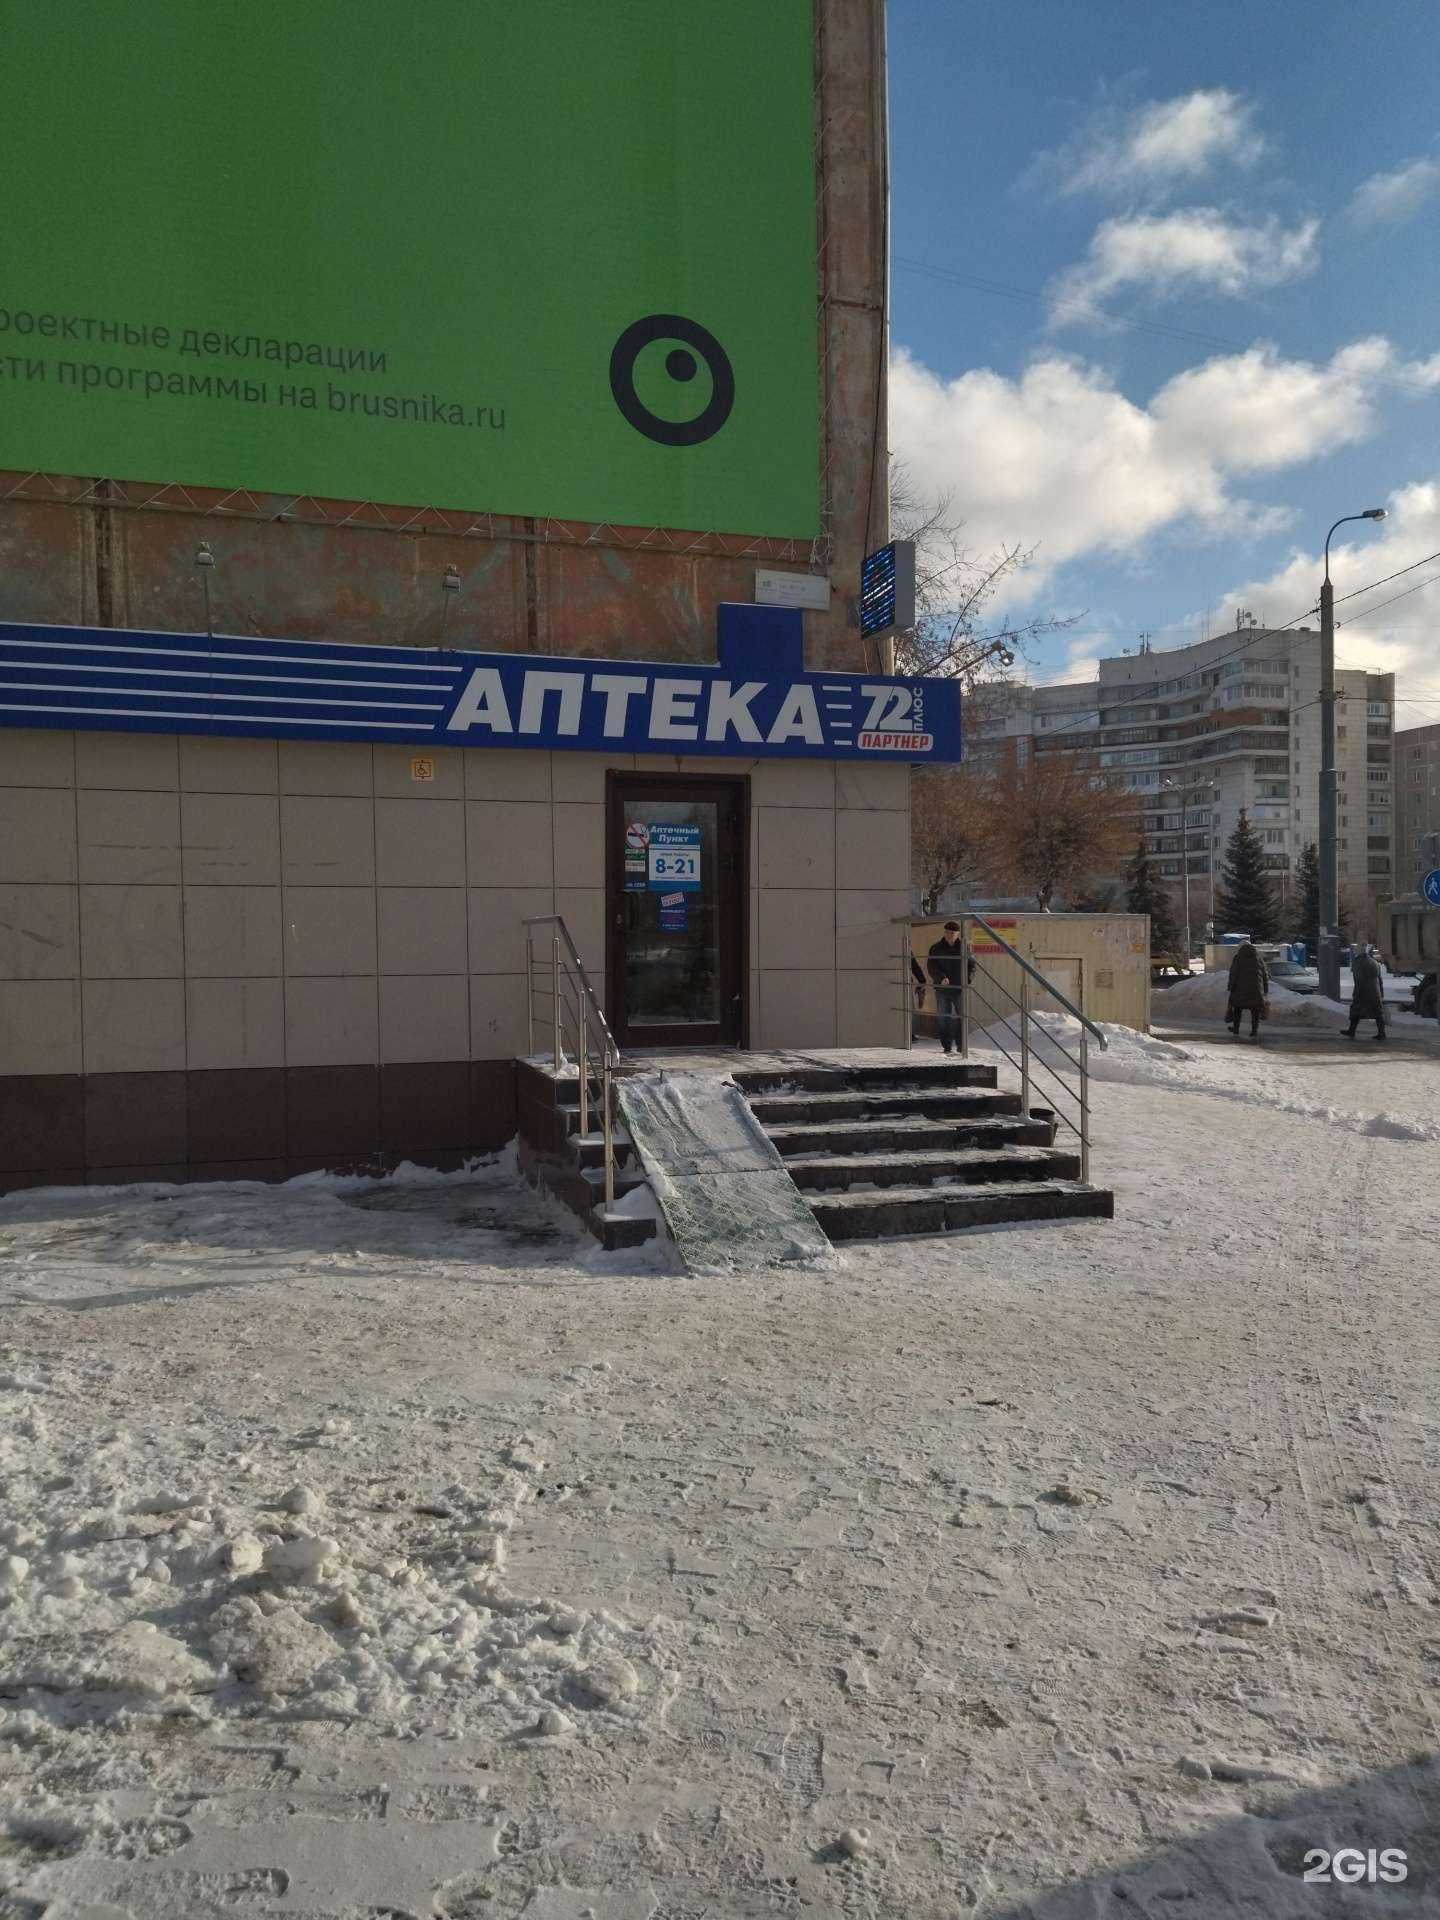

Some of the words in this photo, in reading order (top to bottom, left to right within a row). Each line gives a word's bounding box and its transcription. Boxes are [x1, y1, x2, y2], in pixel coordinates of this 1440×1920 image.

[180, 328, 388, 374] декларации
[0, 356, 46, 382] ти
[58, 361, 268, 404] программы
[280, 382, 317, 409] на
[328, 382, 507, 431] brusnika.ru
[446, 667, 825, 746] АПТЕКА
[861, 684, 913, 732] 72
[913, 687, 924, 731] ПЛЮС
[861, 734, 930, 750] ПАРТНЕР
[650, 825, 699, 835] Аптечный
[658, 834, 689, 844] Пункт
[655, 858, 695, 874] 8-21
